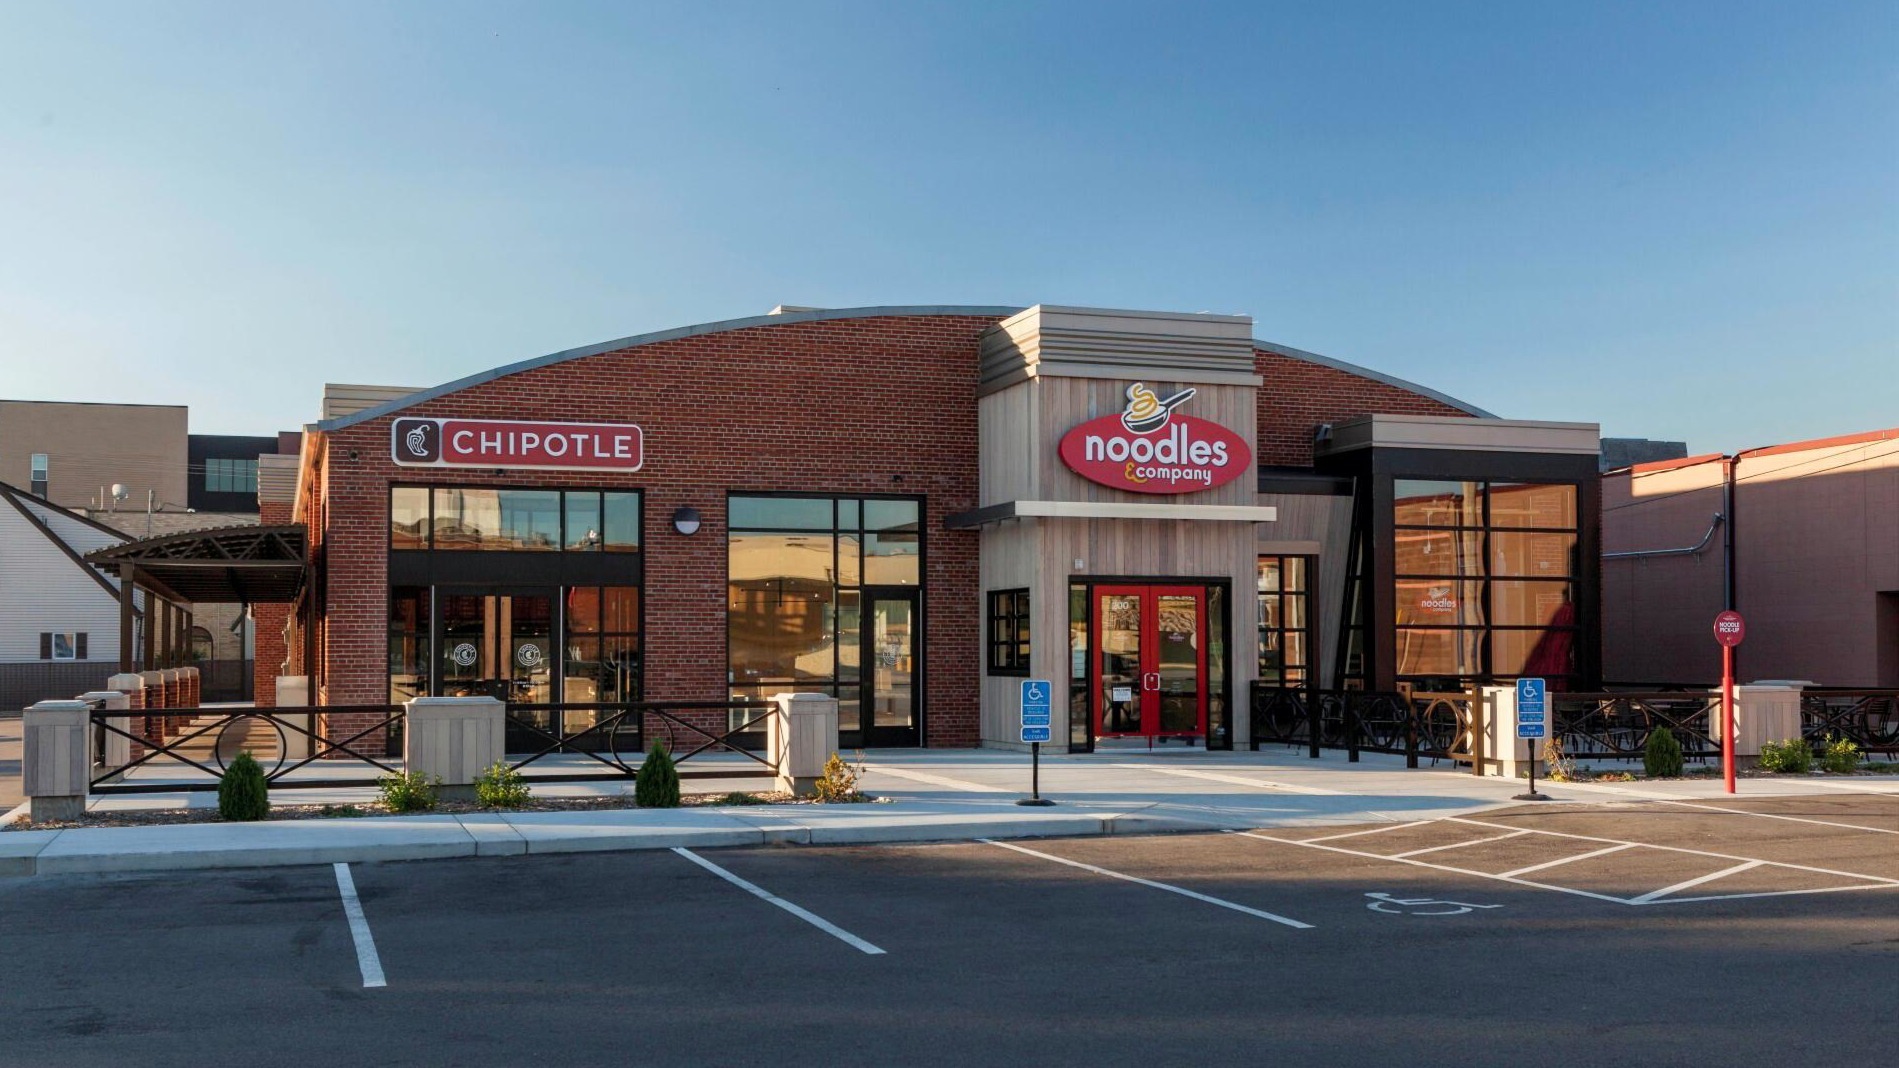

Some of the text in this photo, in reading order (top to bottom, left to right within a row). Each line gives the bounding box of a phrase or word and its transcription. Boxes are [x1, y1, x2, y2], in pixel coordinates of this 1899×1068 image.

[452, 430, 632, 459] CHIPOTLE
[1085, 422, 1229, 466] noodles
[1421, 598, 1457, 608] noodles
